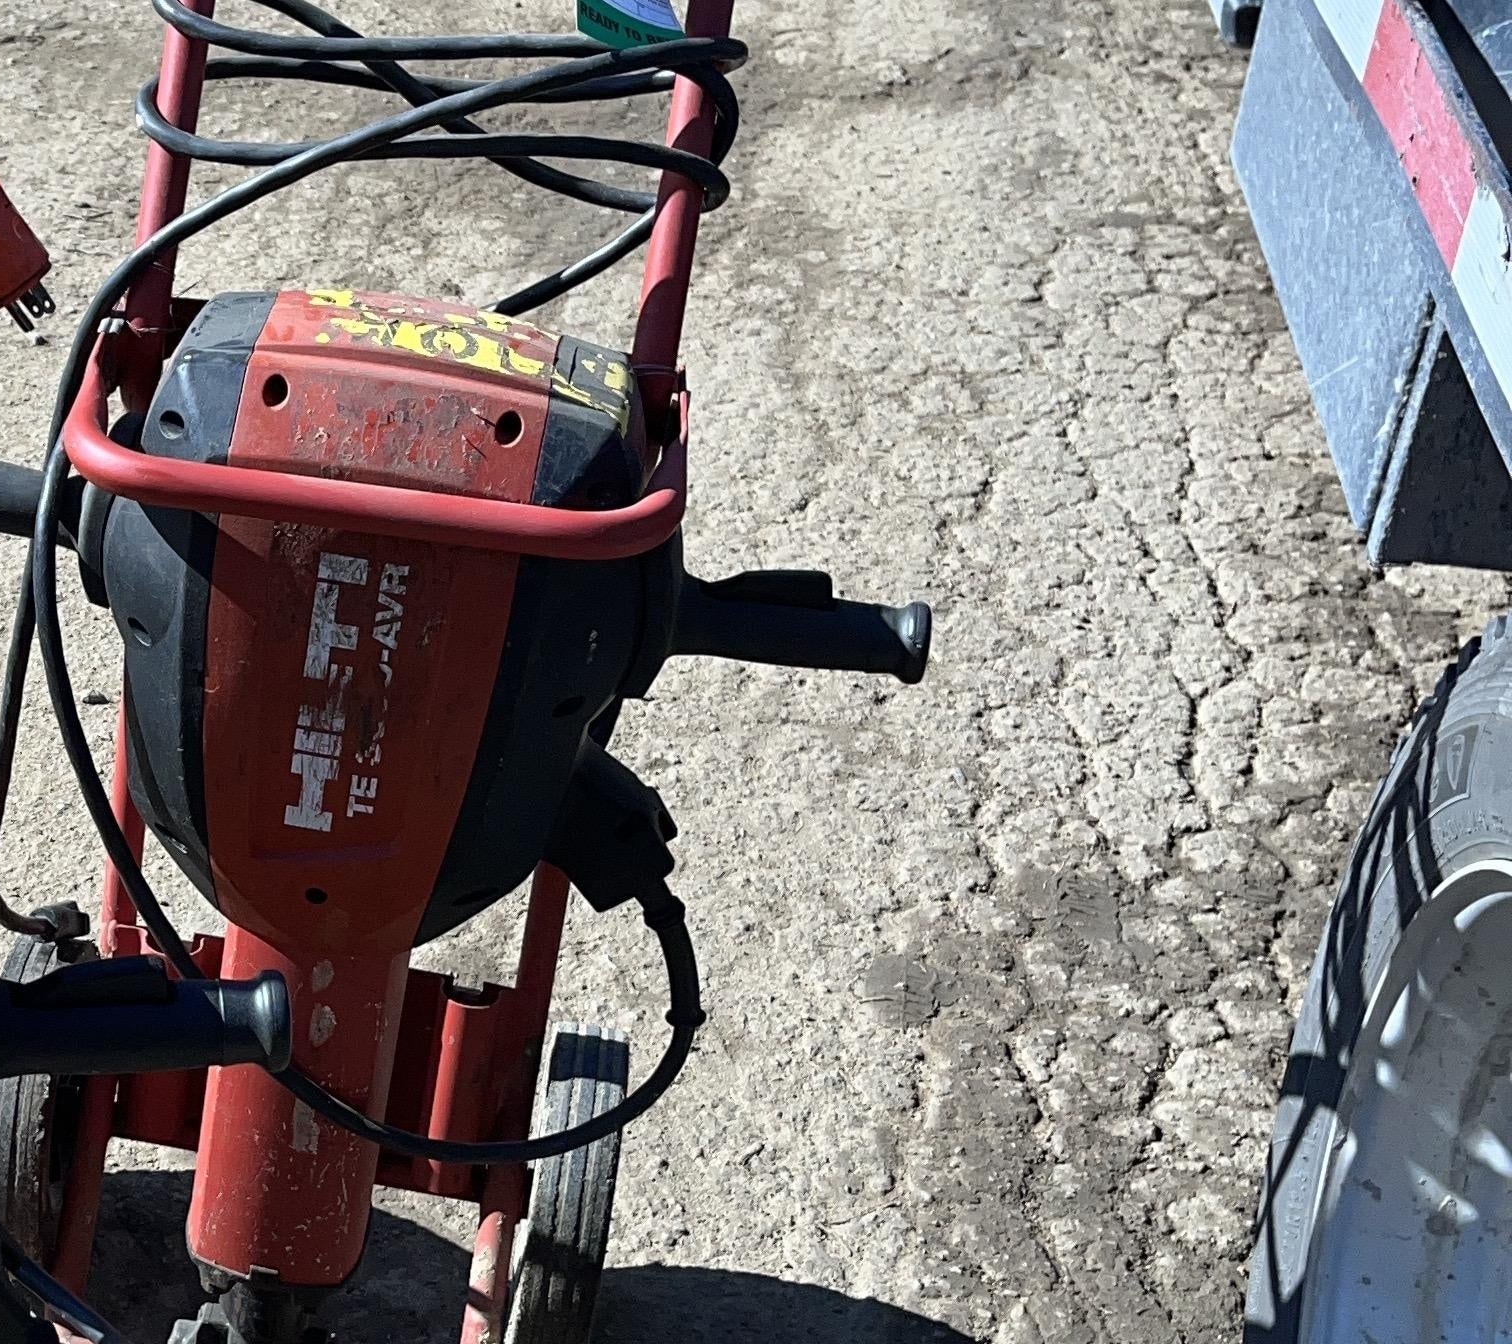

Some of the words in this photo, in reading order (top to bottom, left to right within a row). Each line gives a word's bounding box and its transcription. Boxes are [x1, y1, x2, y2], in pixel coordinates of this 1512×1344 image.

[579, 0, 620, 33] READY
[624, 26, 643, 42] TO
[283, 551, 369, 834] HILTI
[346, 774, 378, 818] TE
